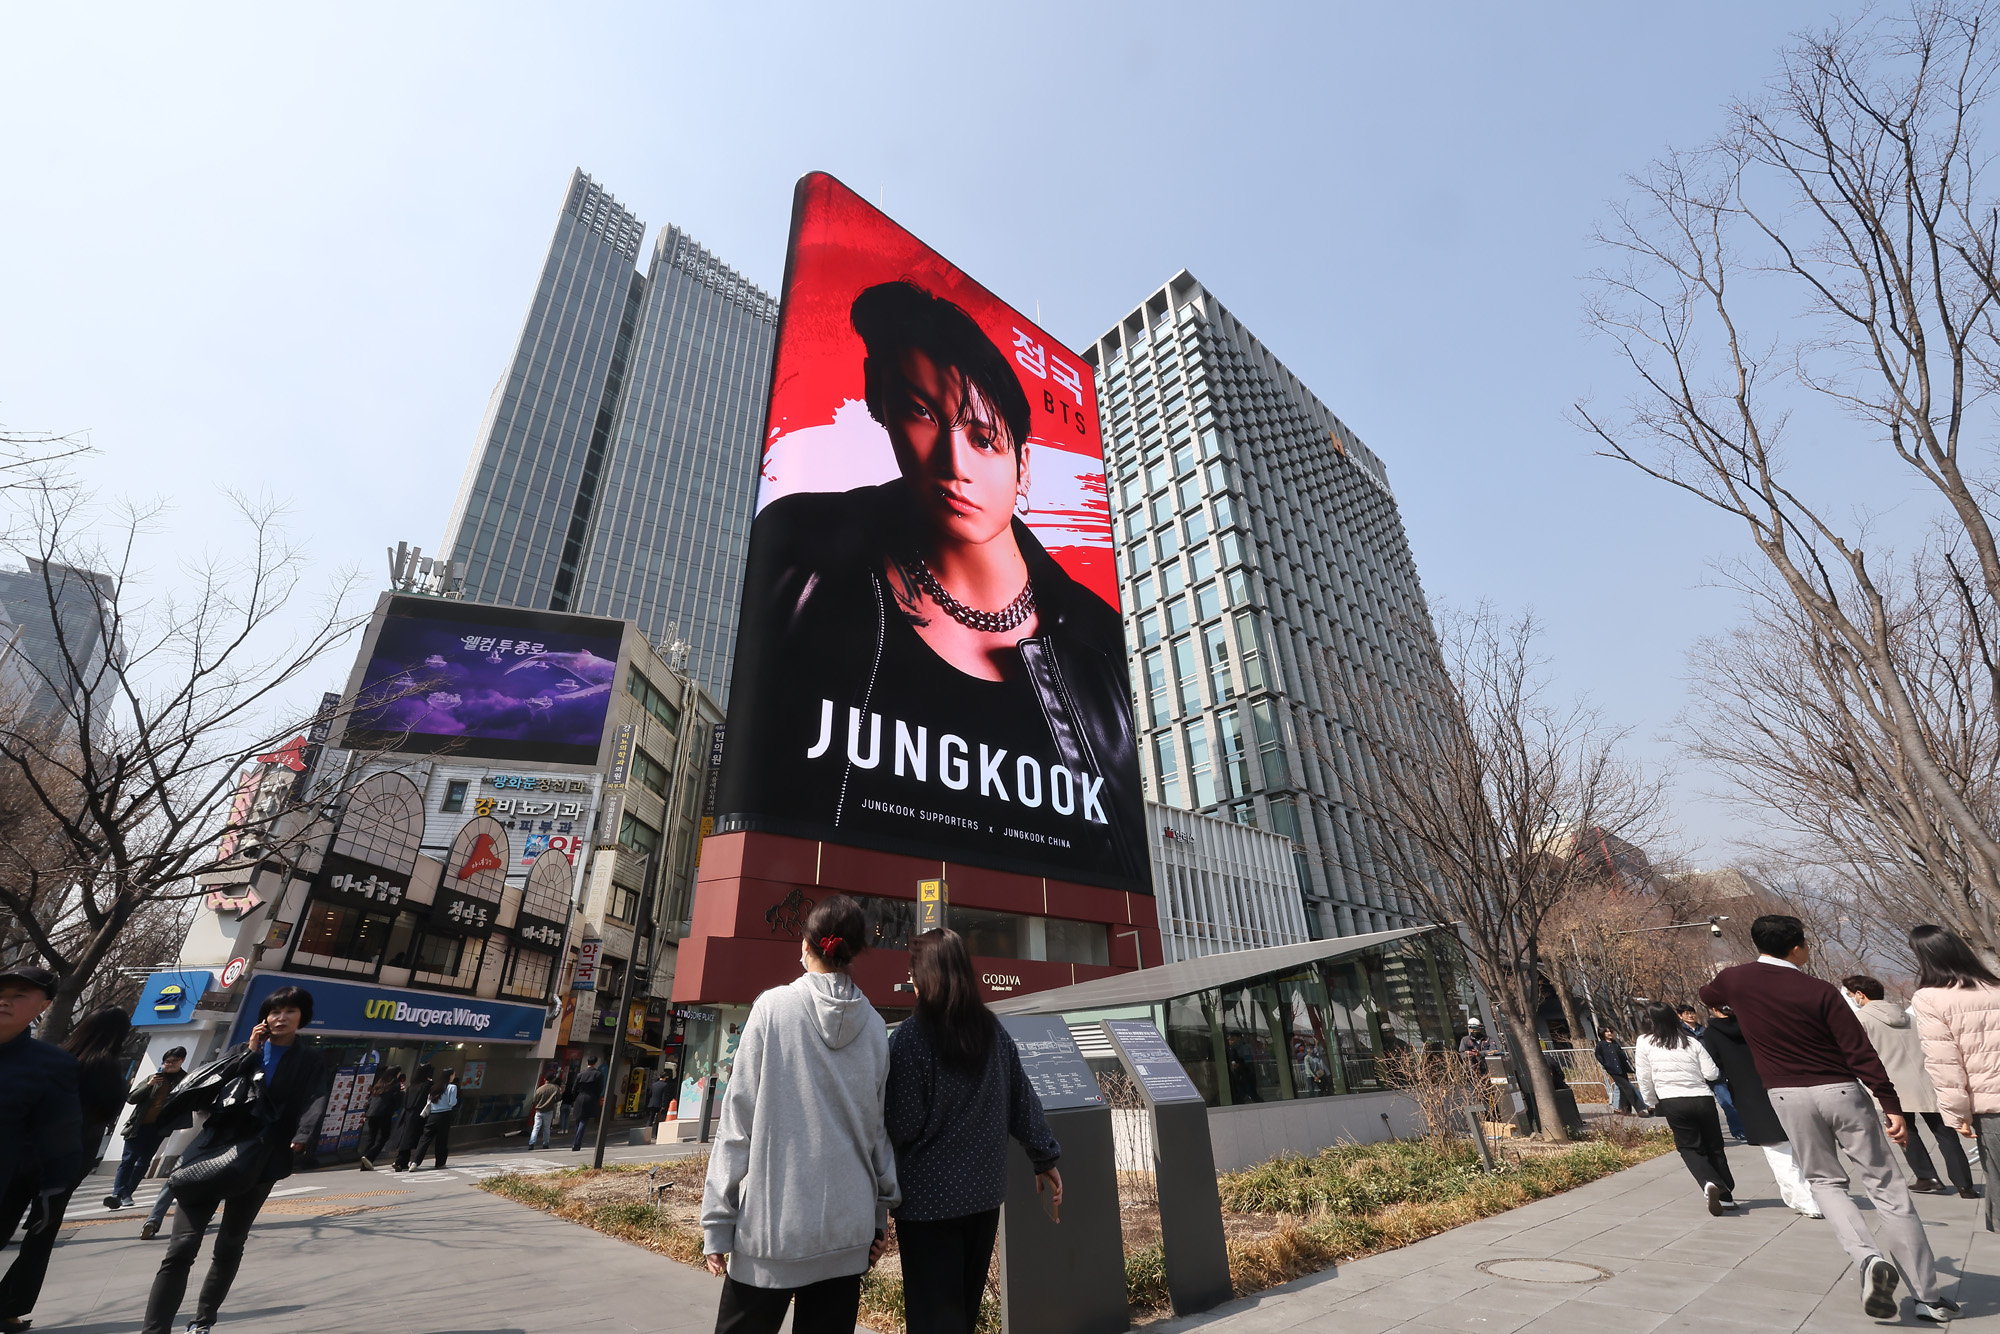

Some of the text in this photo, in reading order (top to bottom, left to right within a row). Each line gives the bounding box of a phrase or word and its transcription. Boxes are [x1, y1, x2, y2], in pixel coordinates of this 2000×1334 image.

[1011, 326, 1083, 406] 정국
[1043, 389, 1086, 435] BTS
[461, 635, 548, 656] 웰컴 투 종로
[807, 698, 1109, 825] JUNGKOOK
[474, 797, 583, 821] 강비뇨기과
[861, 798, 916, 817] JUNGKOOK
[919, 809, 979, 830] SUPPORTERS
[1003, 827, 1046, 845] JUNGKOOK
[1048, 836, 1071, 849] CHINA
[331, 874, 402, 905] 마녀김밥
[448, 900, 488, 928] 청담동
[926, 904, 934, 915] 7
[226, 965, 241, 985] 30
[578, 943, 598, 980] 약국
[982, 973, 1021, 986] GODIVA
[677, 1009, 681, 1017] A
[681, 1009, 702, 1021] TWOSOME
